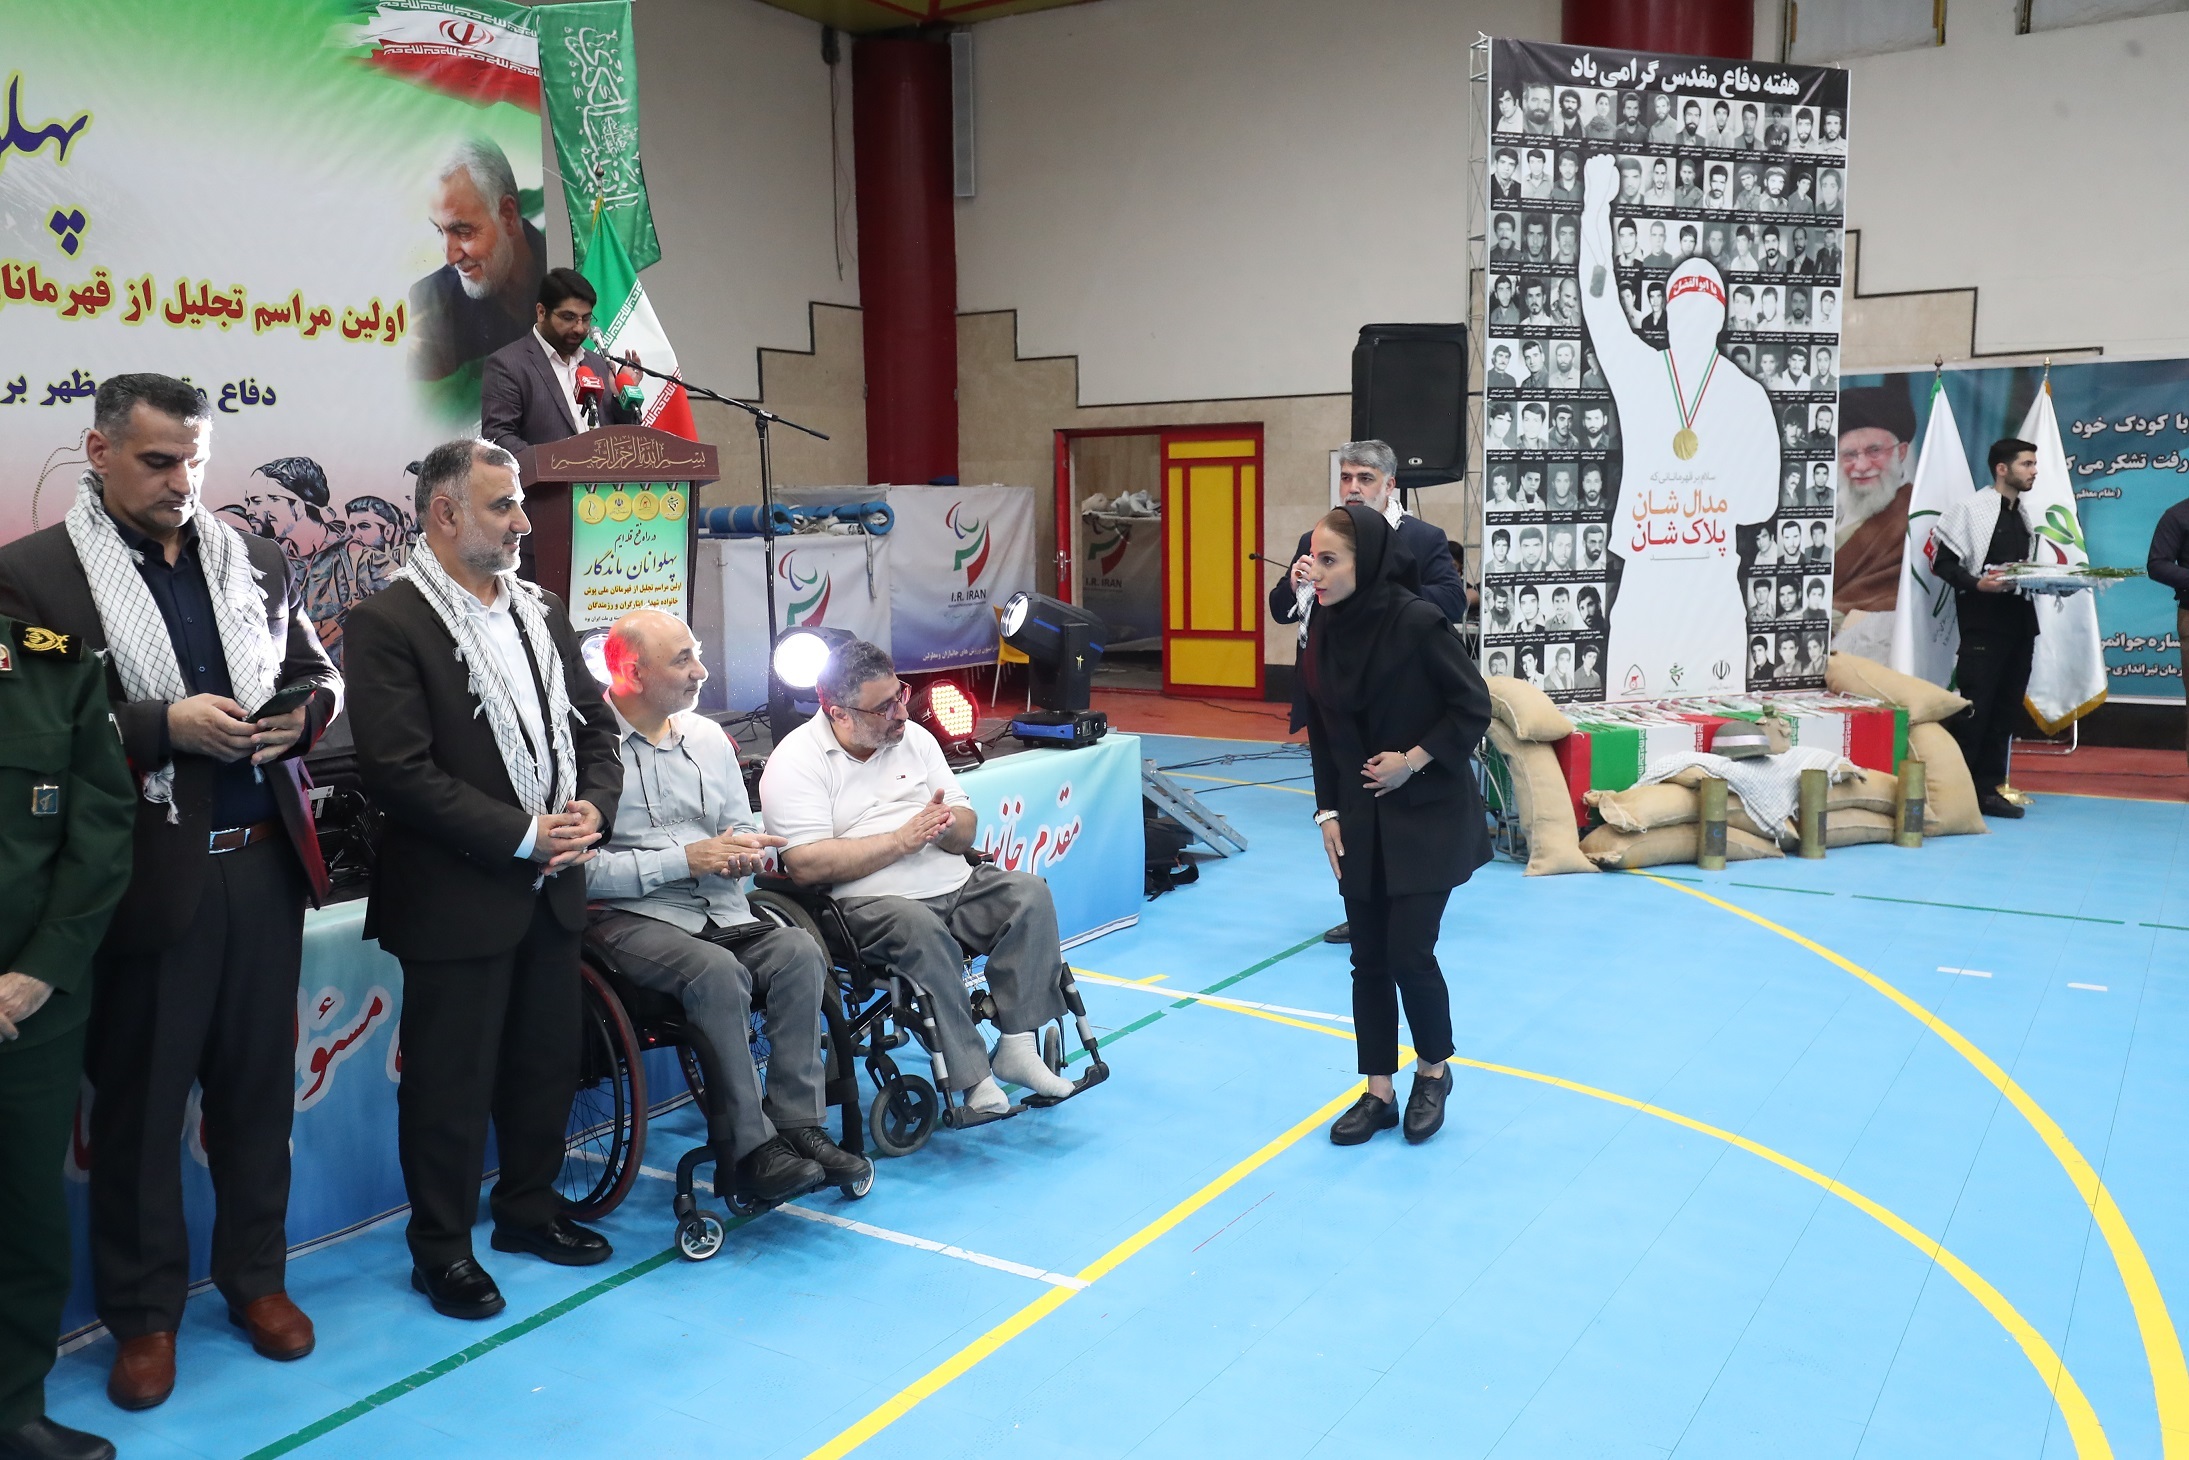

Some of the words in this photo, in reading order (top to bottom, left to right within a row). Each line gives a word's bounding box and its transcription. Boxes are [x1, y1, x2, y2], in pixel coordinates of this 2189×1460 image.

[1570, 53, 1598, 86] باد
[1600, 57, 1660, 90] گرامی
[1660, 64, 1718, 93] مقدس
[1719, 65, 1761, 98] دفاع
[1763, 71, 1800, 96] هفته
[0, 263, 111, 316] قهرمانا
[125, 278, 152, 321] از
[165, 283, 244, 327] تجلیل
[255, 293, 331, 335] مراسم
[341, 302, 404, 343] اولین
[40, 369, 96, 406] ظهر
[218, 380, 277, 413] دفاع
[2071, 416, 2108, 439] خود
[2114, 413, 2169, 436] کودک
[2078, 460, 2104, 475] می
[2106, 453, 2147, 474] تشکر
[1632, 489, 1679, 521] شان
[1683, 488, 1728, 518] مدال
[1631, 520, 1678, 552] شان
[1682, 517, 1726, 557] پلاک
[583, 549, 623, 577] ماندگار
[626, 550, 678, 582] پهلوانان
[598, 586, 609, 596] ملی
[610, 585, 632, 595] قهرمانان
[640, 584, 653, 594] تجلیل
[654, 584, 669, 593] مراسم
[669, 582, 682, 592] اولین
[951, 591, 964, 602] I.R.
[966, 589, 987, 600] IRAN
[1102, 578, 1122, 588] IRAN
[587, 601, 613, 611] رزمندگان
[661, 597, 678, 606] خانواده
[2101, 632, 2146, 652] جوانمر
[2112, 663, 2158, 677] تیراندازی
[2160, 664, 2182, 677] رمان
